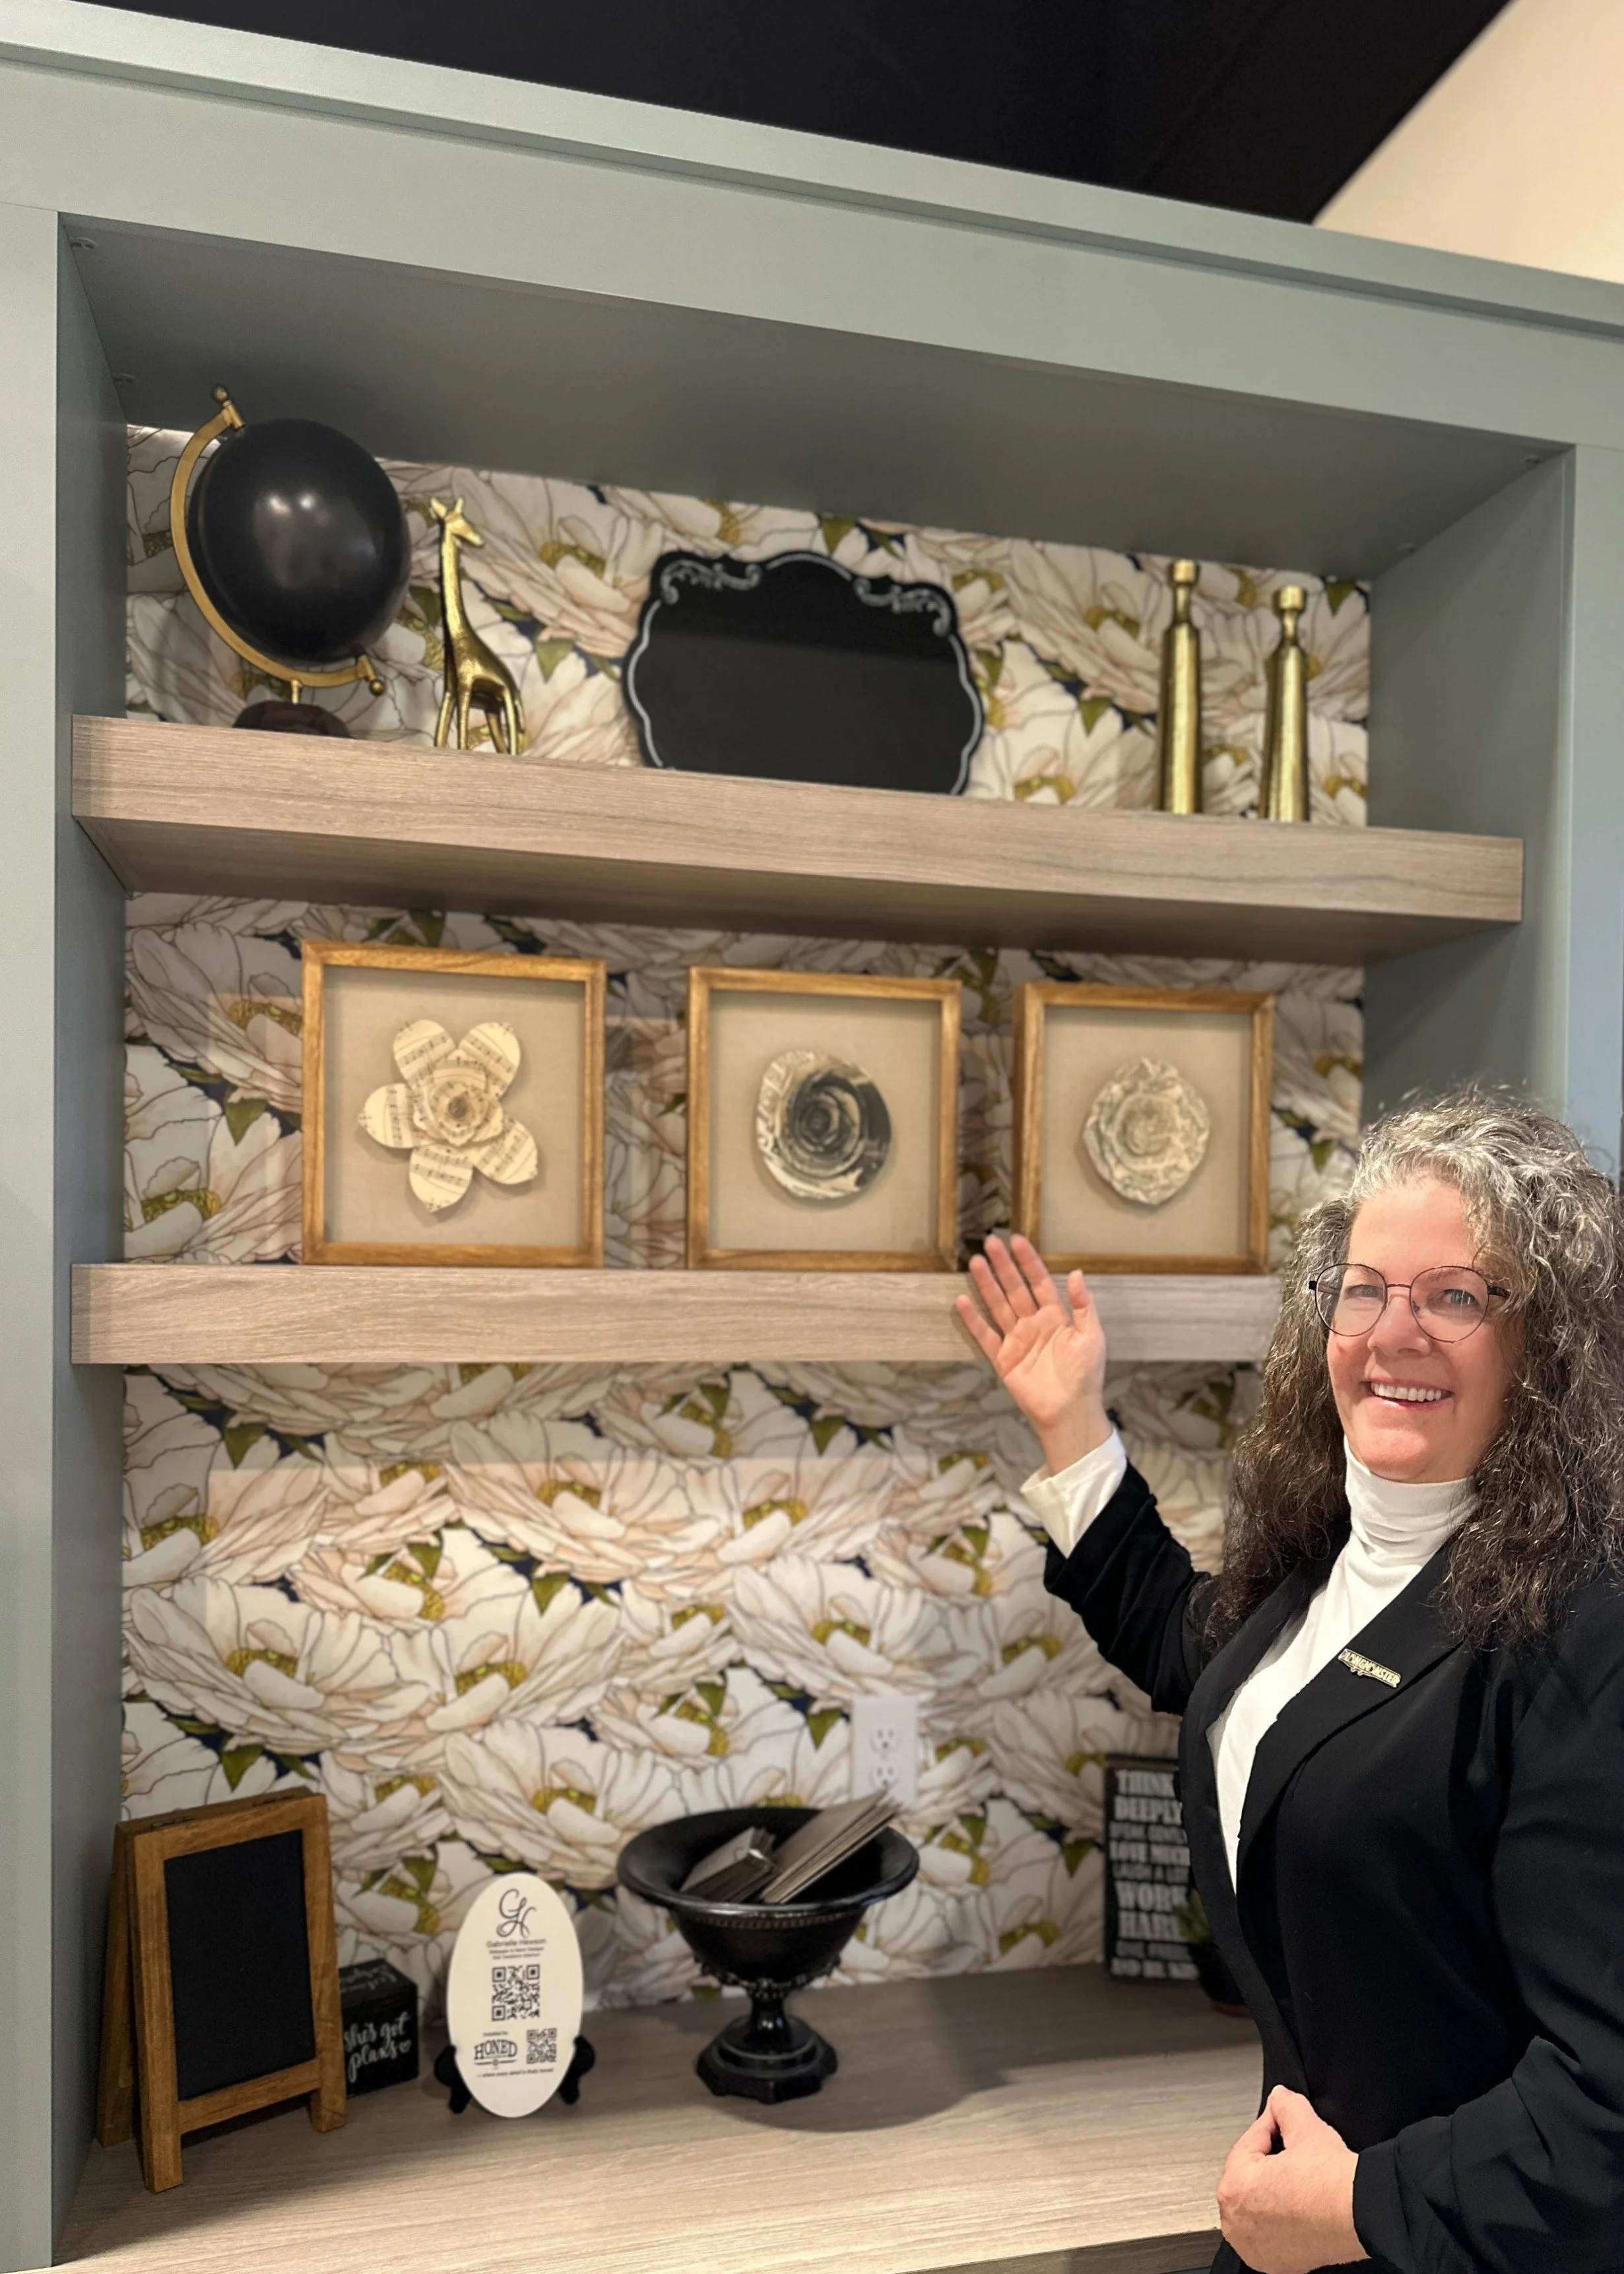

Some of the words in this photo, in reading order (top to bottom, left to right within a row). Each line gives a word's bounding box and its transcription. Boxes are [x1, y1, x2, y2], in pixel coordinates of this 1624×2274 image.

[1115, 1769, 1175, 1796] THINK
[1114, 1796, 1183, 1825] DEEPLY
[1109, 1840, 1147, 1862] LOVE
[1115, 1881, 1188, 1912] WORK
[344, 2023, 377, 2053] she's
[380, 2011, 410, 2050] got
[348, 2040, 398, 2083] plans
[474, 2039, 518, 2060] HONED
